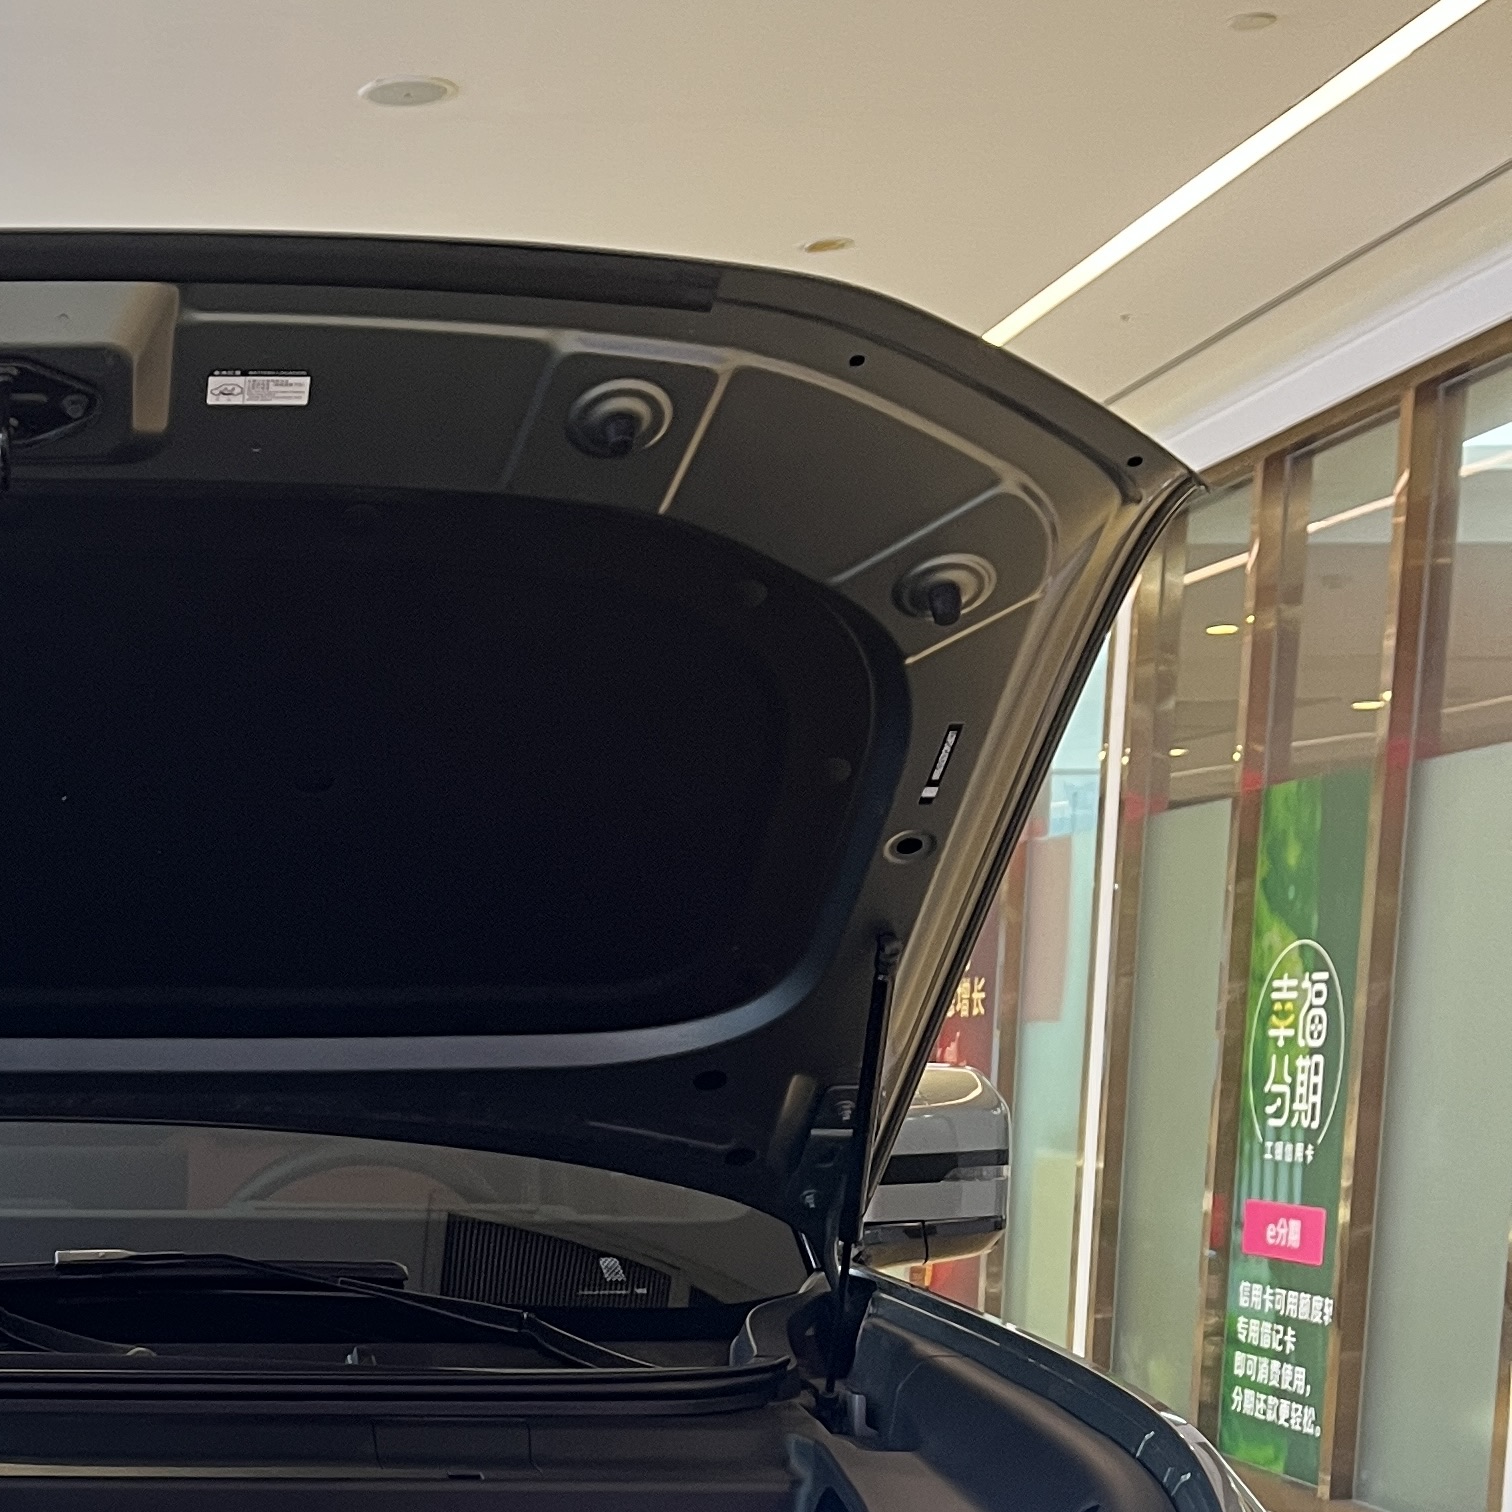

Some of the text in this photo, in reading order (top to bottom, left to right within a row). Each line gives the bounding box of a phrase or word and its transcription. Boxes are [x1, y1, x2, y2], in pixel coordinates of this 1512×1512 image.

[947, 977, 985, 1017] 增长
[1268, 971, 1330, 1048] 幸福
[1264, 1054, 1324, 1129] 分期
[1266, 1218, 1301, 1249] e分期
[1236, 1316, 1296, 1355] 专用借记卡
